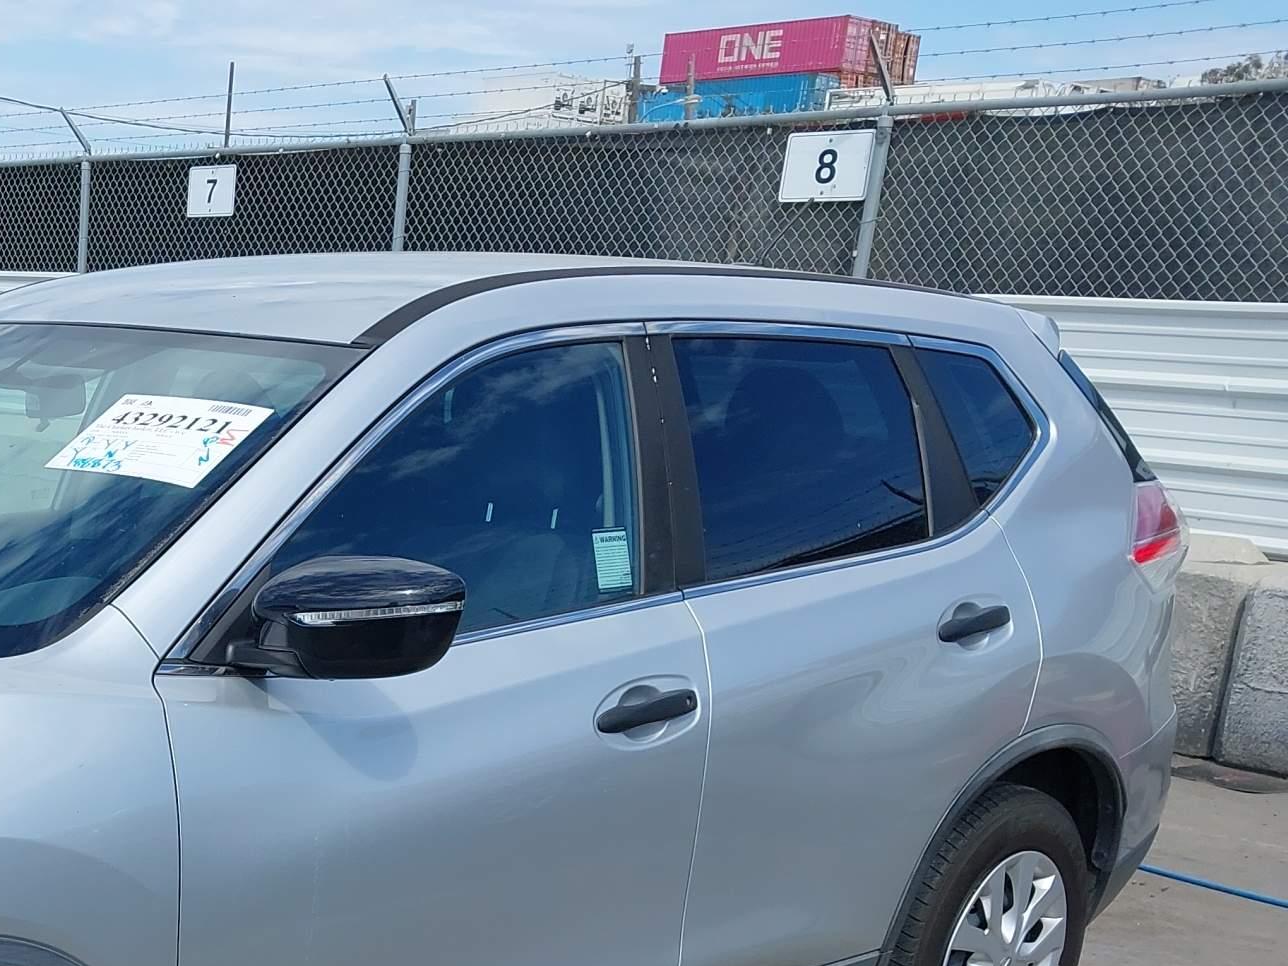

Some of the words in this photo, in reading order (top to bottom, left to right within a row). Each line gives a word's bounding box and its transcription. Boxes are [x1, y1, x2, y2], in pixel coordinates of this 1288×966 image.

[718, 29, 783, 63] ONE
[815, 149, 838, 184] 8
[206, 179, 217, 204] 7
[112, 410, 233, 434] 43292121
[600, 535, 626, 543] WARNING
